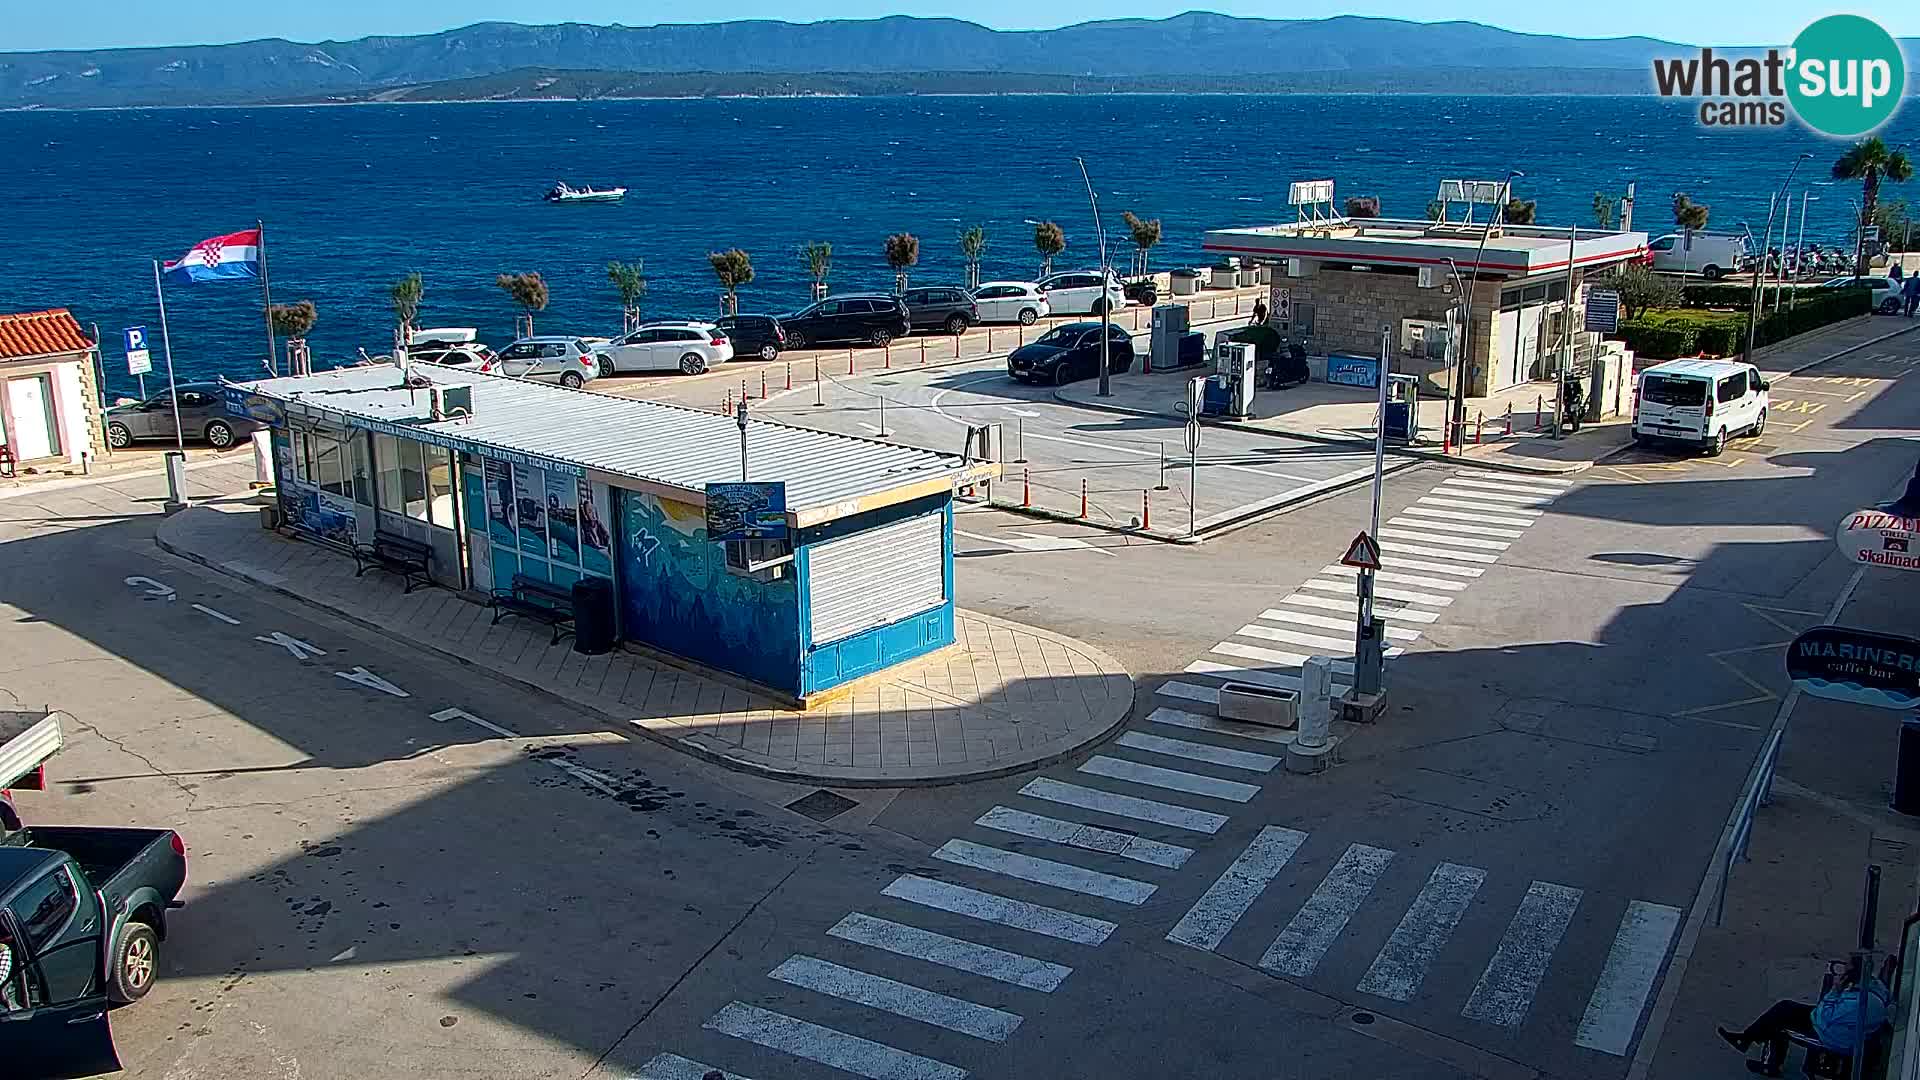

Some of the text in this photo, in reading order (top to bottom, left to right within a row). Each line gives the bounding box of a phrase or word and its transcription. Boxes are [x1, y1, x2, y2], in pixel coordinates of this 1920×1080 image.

[128, 330, 142, 349] P
[1811, 374, 1880, 387] TAXI
[395, 426, 435, 443] AUTOBUSNA
[436, 437, 467, 451] POSTAJA
[478, 444, 493, 457] BUS
[494, 449, 526, 464] STATION
[527, 457, 553, 470] TICKET
[555, 463, 582, 477] OFFICE
[1869, 665, 1896, 679] bar
